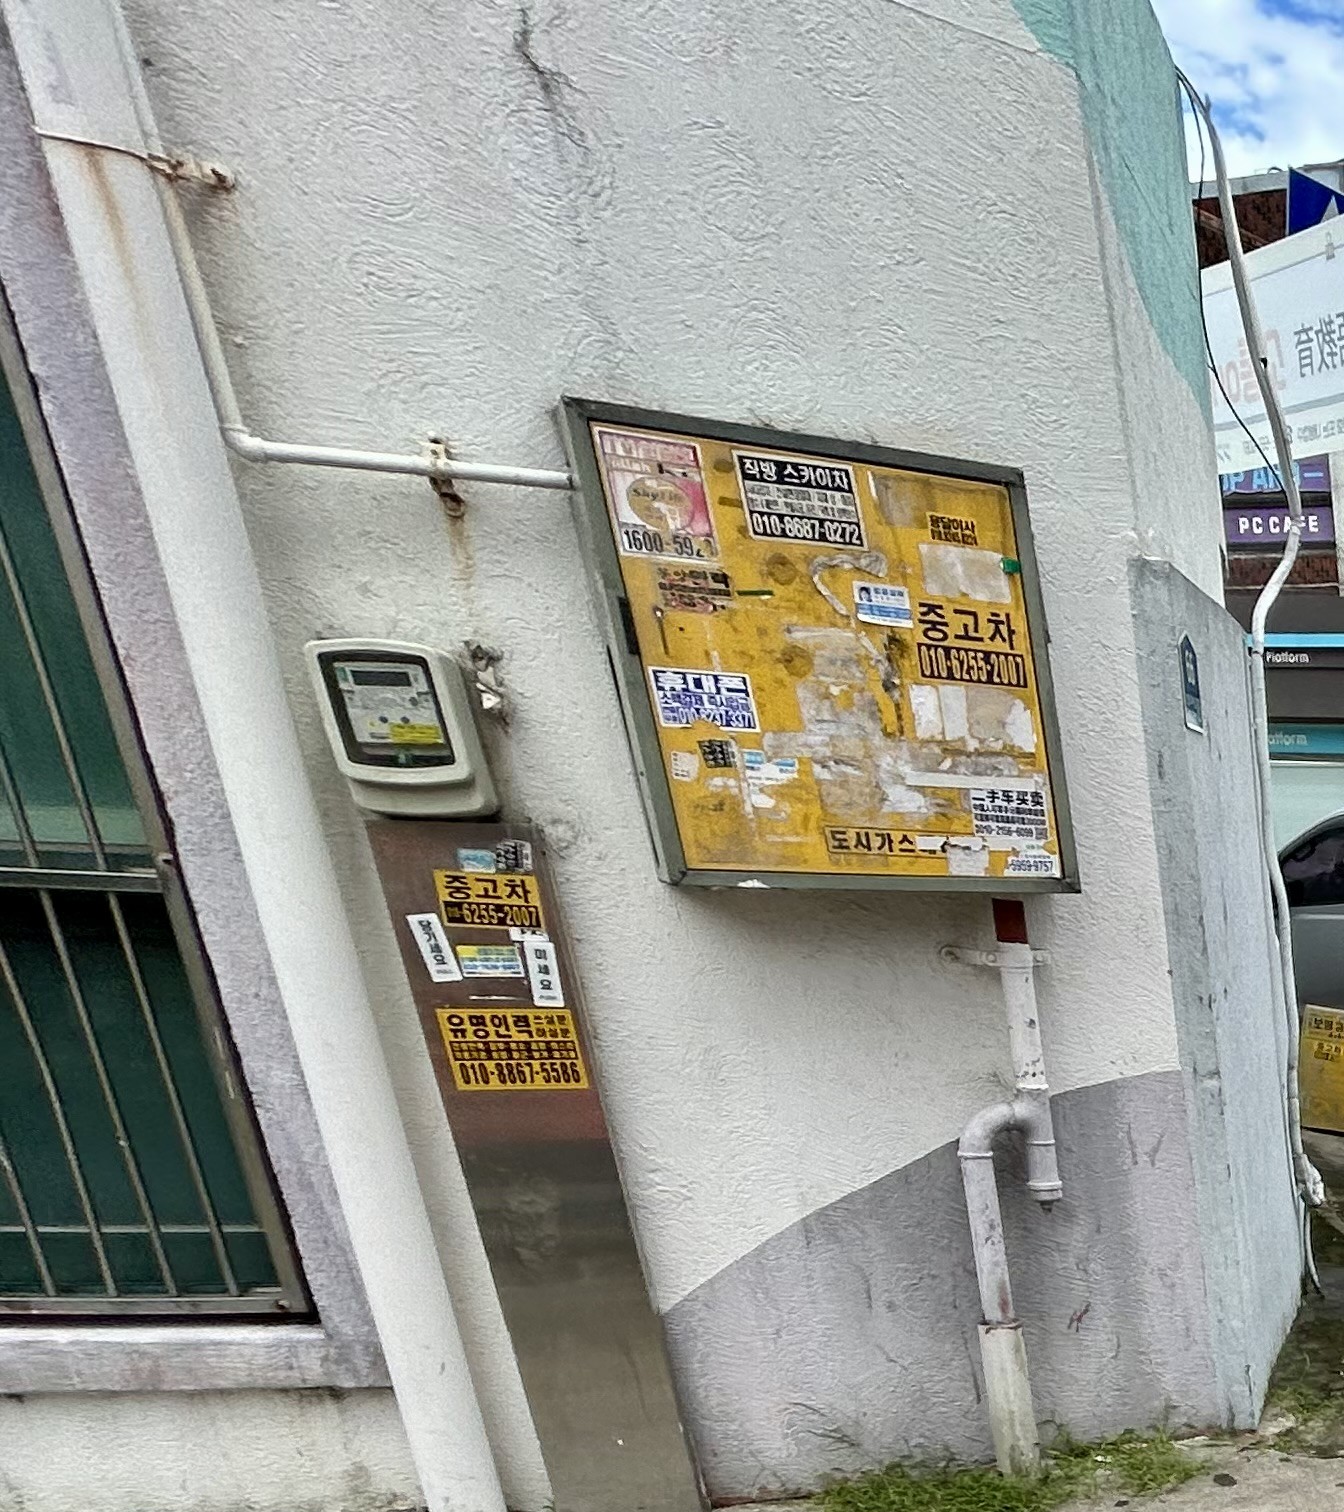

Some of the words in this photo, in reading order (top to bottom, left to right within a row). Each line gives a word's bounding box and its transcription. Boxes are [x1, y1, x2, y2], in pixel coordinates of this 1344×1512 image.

[1238, 517, 1263, 535] PC
[917, 601, 1017, 651] 중고차
[970, 789, 1044, 808] 二手车买卖
[445, 874, 532, 905] 중고차
